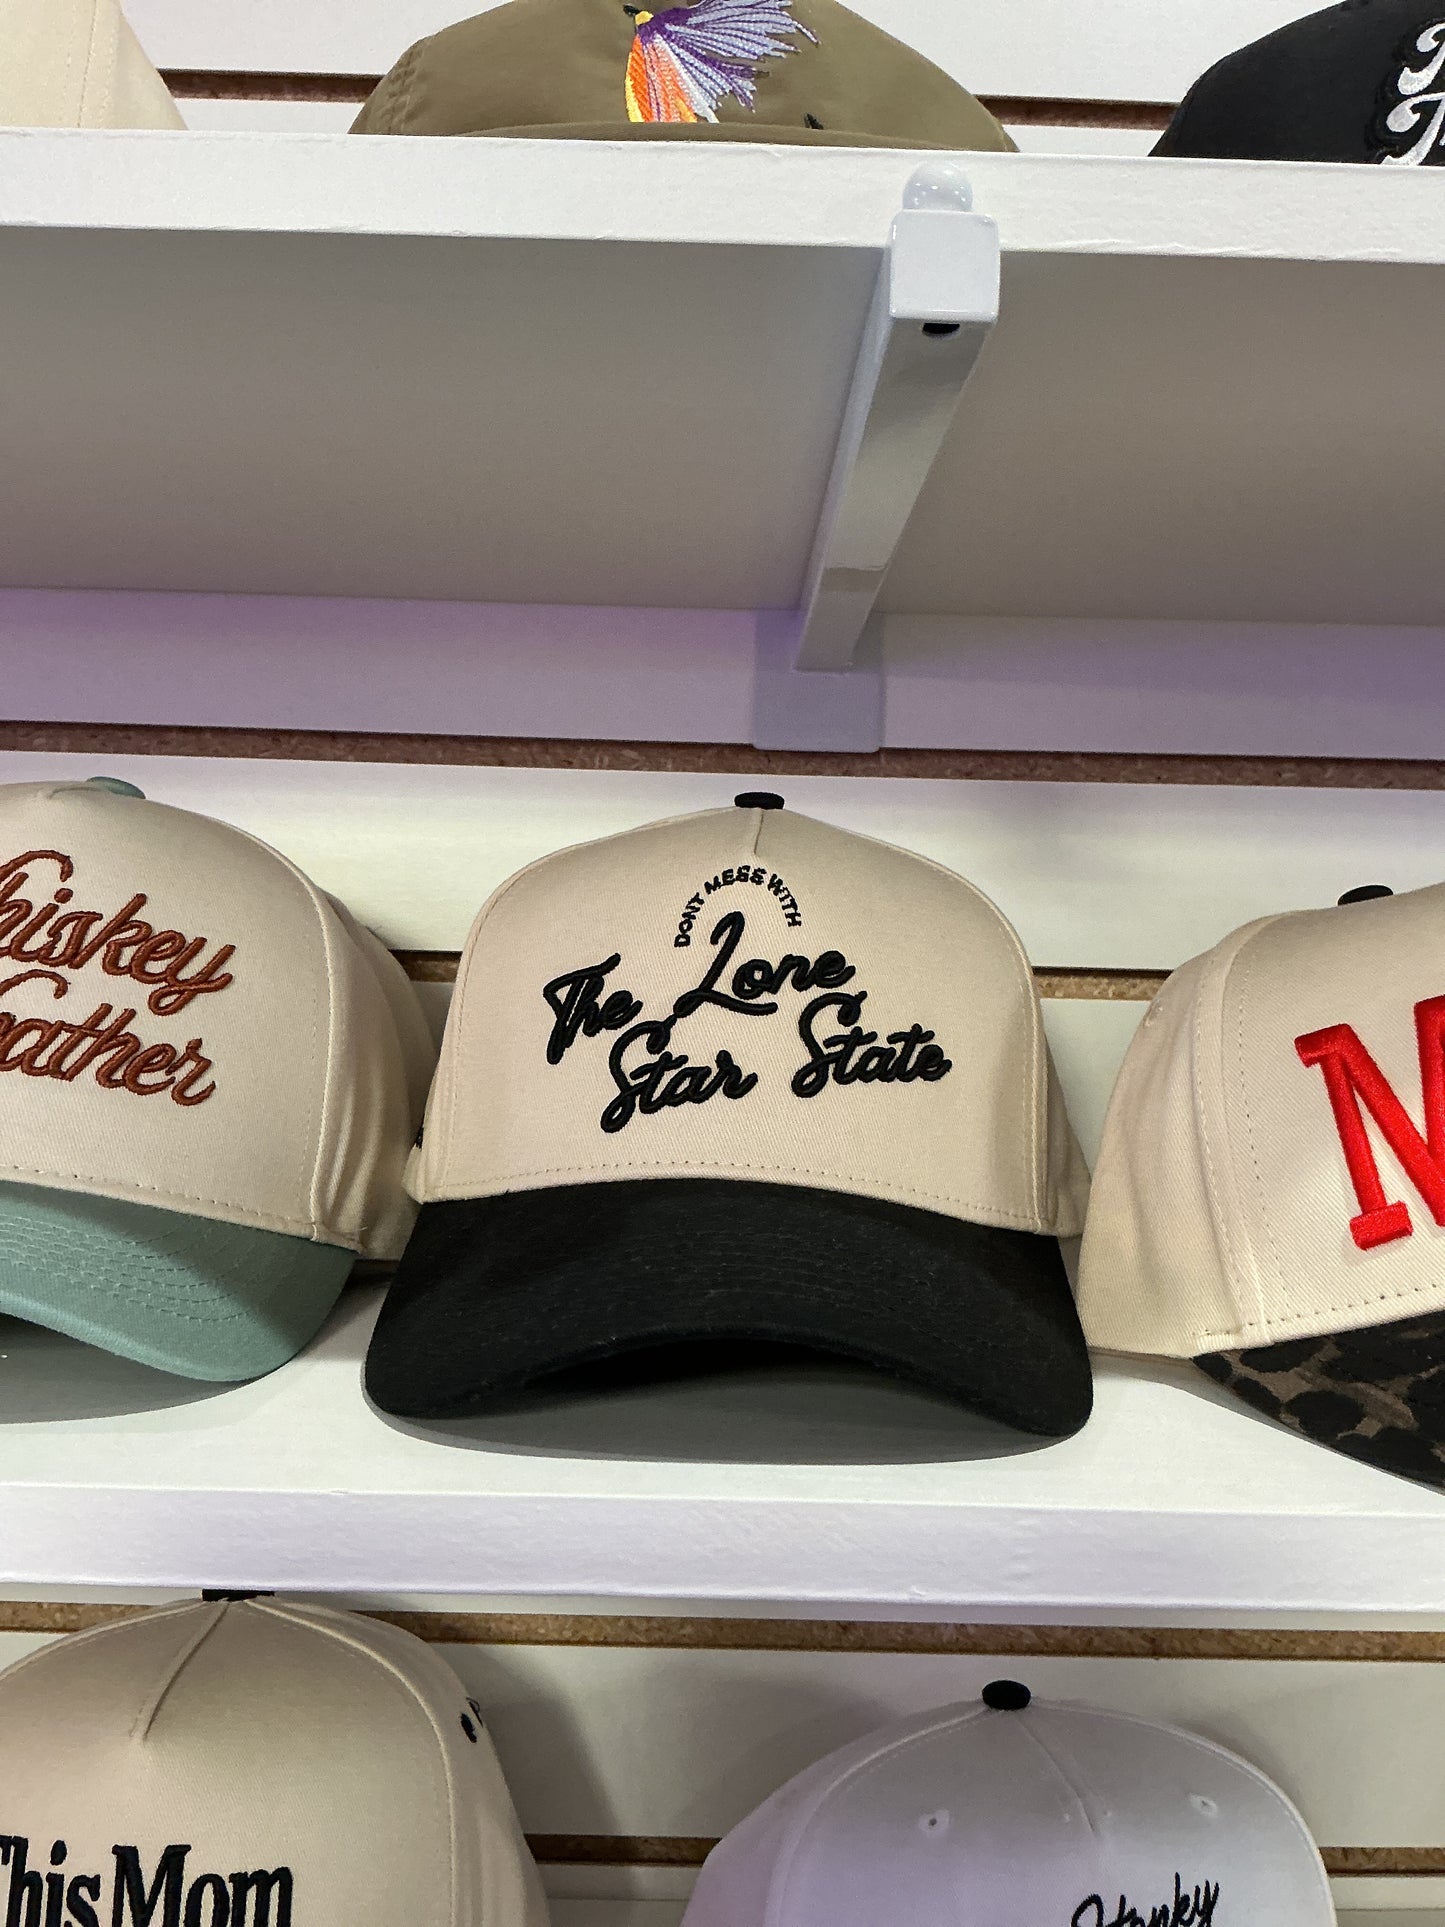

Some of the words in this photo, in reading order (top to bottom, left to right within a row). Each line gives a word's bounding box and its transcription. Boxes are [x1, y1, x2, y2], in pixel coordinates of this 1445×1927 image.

[0, 849, 236, 1016] hiskey
[704, 865, 767, 895] MESS
[767, 873, 802, 927] WITH
[0, 968, 216, 1107] ather
[542, 953, 643, 1065] The
[674, 911, 856, 1016] Lone
[600, 1013, 759, 1133] Star
[791, 991, 953, 1098] State
[111, 1844, 294, 1927] Mom
